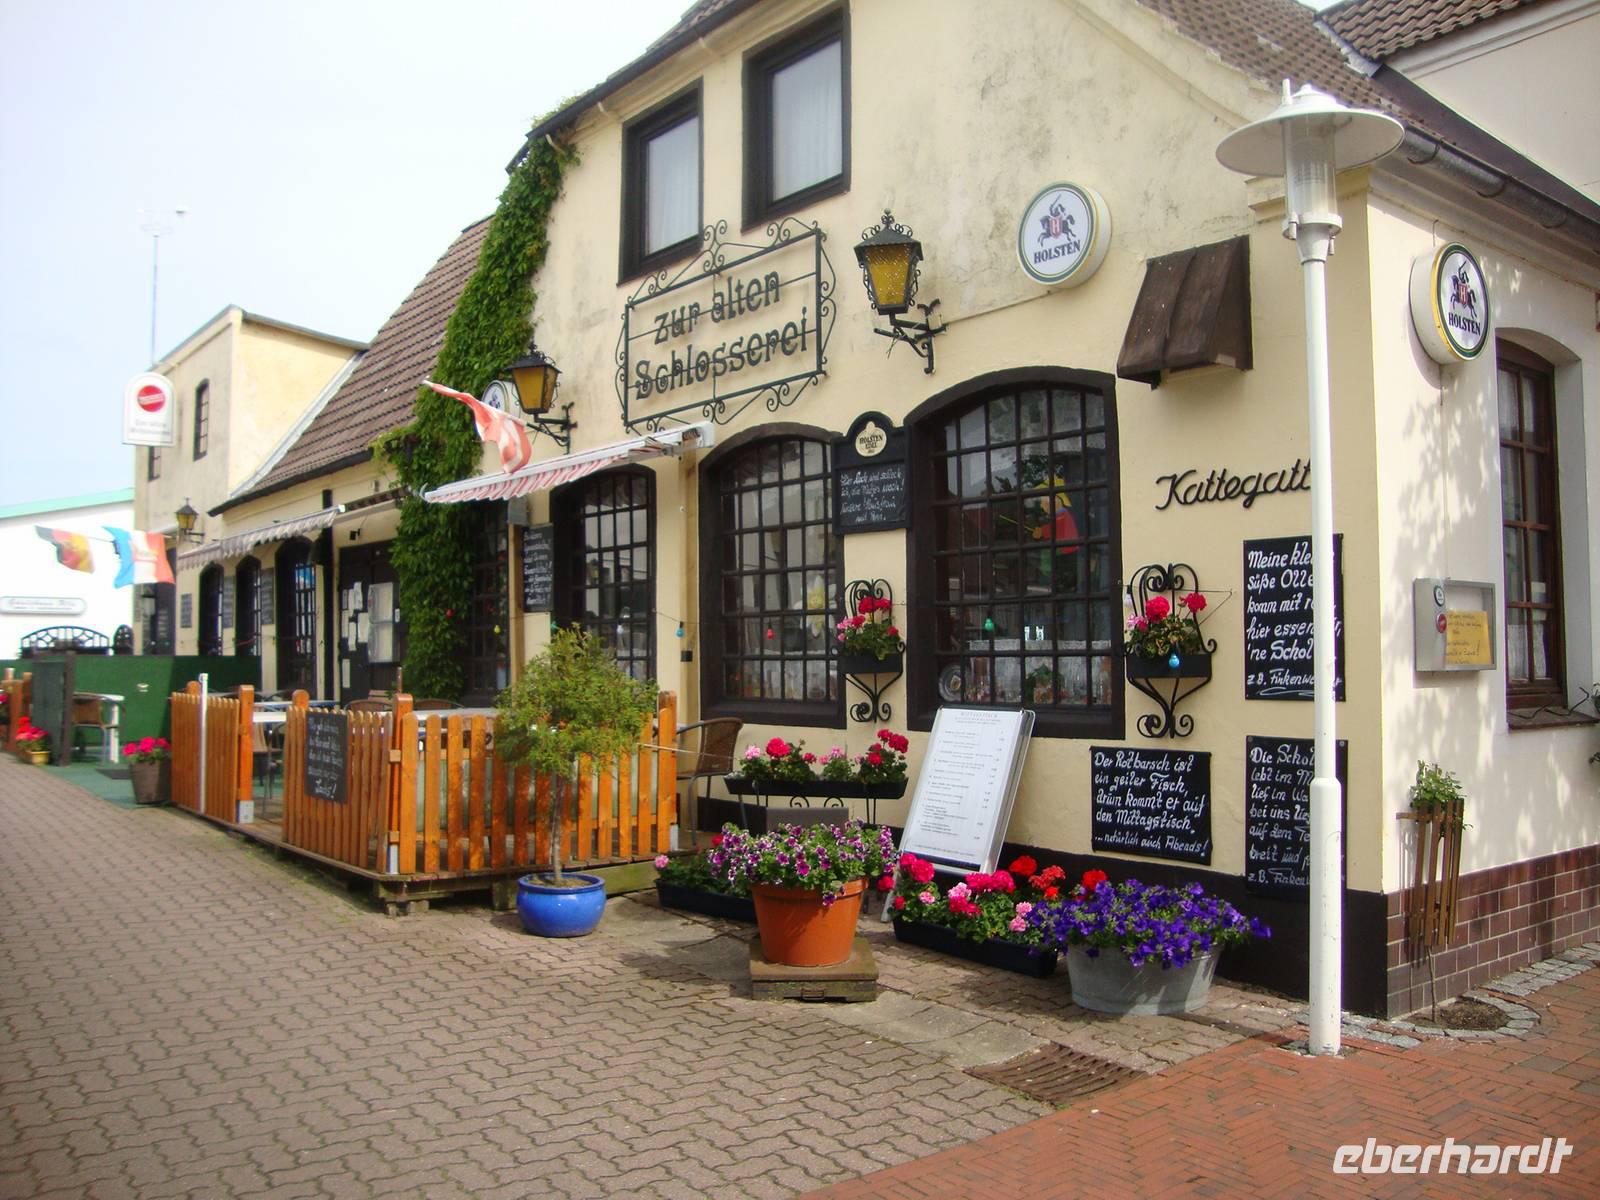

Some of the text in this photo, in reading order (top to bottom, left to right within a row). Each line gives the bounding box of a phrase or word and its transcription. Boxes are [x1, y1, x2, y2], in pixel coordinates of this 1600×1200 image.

[1033, 239, 1081, 265] HOLSTEN
[654, 271, 781, 345] zur alten
[1448, 311, 1481, 336] HOLSTEN
[636, 306, 808, 400] Schlosserei
[859, 434, 883, 445] HOLSTEN
[1248, 541, 1313, 568] Meine kle
[1247, 595, 1277, 613] komm
[1280, 592, 1303, 611] mit
[1246, 616, 1271, 640] hier
[1274, 622, 1314, 636] essen
[1270, 638, 1314, 661] Schol
[1094, 751, 1195, 772] Der Rotbarsch ist
[1250, 744, 1315, 766] Die Schol
[1095, 771, 1188, 797] ein geiler Fisch,
[1275, 770, 1292, 784] im
[1125, 787, 1163, 809] kommt
[1165, 797, 1180, 810] er
[1096, 808, 1112, 823] den
[1249, 803, 1268, 818] bei
[1270, 824, 1292, 840] dem
